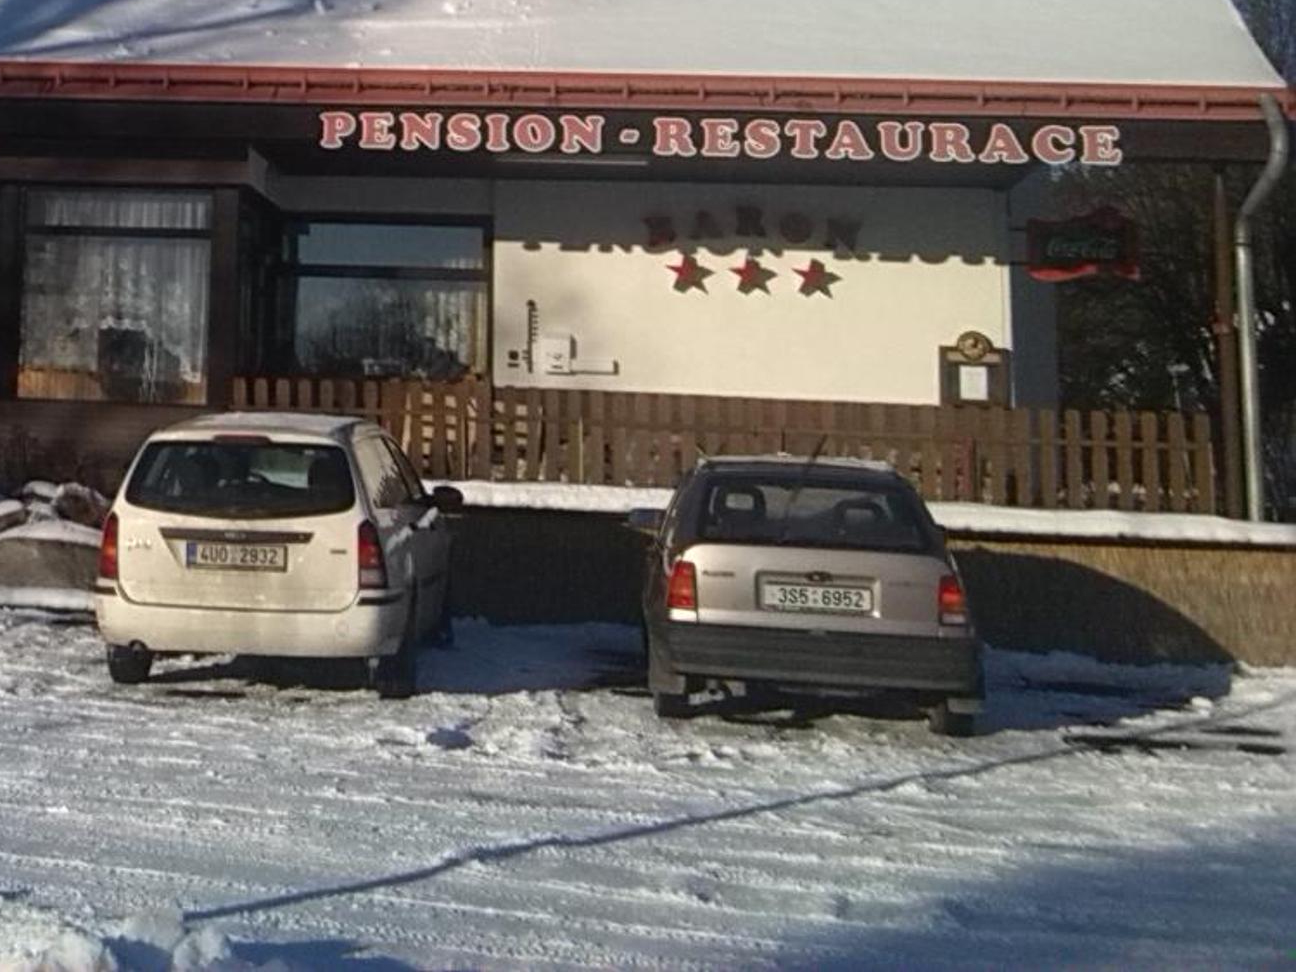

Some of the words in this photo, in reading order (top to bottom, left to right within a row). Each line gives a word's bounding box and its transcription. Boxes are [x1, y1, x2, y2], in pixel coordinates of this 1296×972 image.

[318, 111, 605, 153] PENSION
[652, 116, 1124, 167] RESTAURACE
[821, 589, 864, 608] 6952
